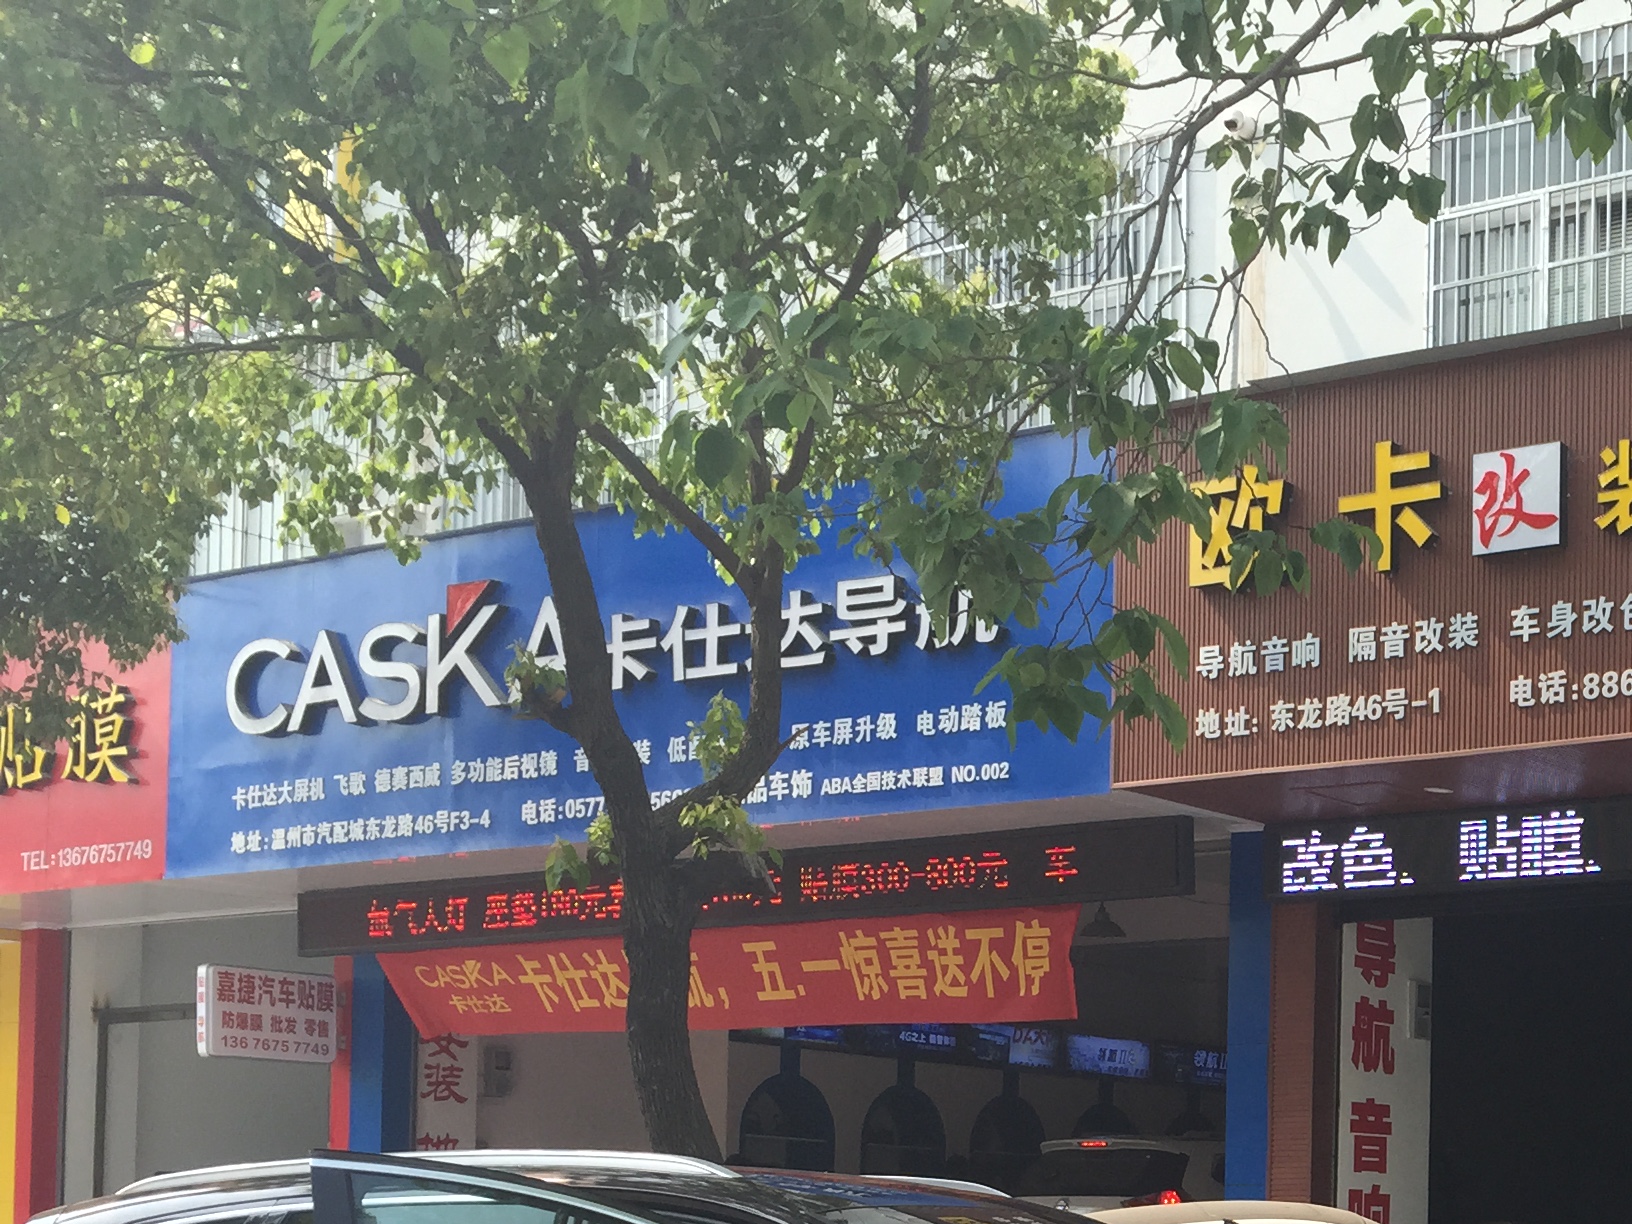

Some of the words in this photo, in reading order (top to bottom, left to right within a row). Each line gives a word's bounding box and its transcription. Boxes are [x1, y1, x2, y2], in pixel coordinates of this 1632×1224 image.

[1195, 633, 1321, 679] 导航音响
[1347, 613, 1479, 663] 隔音改装
[231, 777, 325, 811] 卡仕达大屏机
[333, 770, 366, 796] 飞歌
[374, 762, 441, 794] 德赛西威
[451, 750, 557, 785] 多功能后视镜
[789, 712, 898, 750] 原车屏升级
[916, 700, 1008, 736] 电动踏板
[820, 766, 944, 796] ABA全国技术联盟
[951, 761, 1010, 784] NO.002
[21, 840, 152, 872] TEL:13676757749
[414, 959, 516, 989] CASKA
[216, 970, 335, 1013] 嘉捷汽车贴膜
[449, 994, 512, 1014] 卡仕达
[221, 1010, 263, 1033] 防爆膜
[270, 1014, 297, 1035] 批发
[304, 1018, 330, 1038] 零售
[221, 1035, 249, 1050] 136
[252, 1037, 290, 1053] 7675
[293, 1040, 330, 1056] 7749
